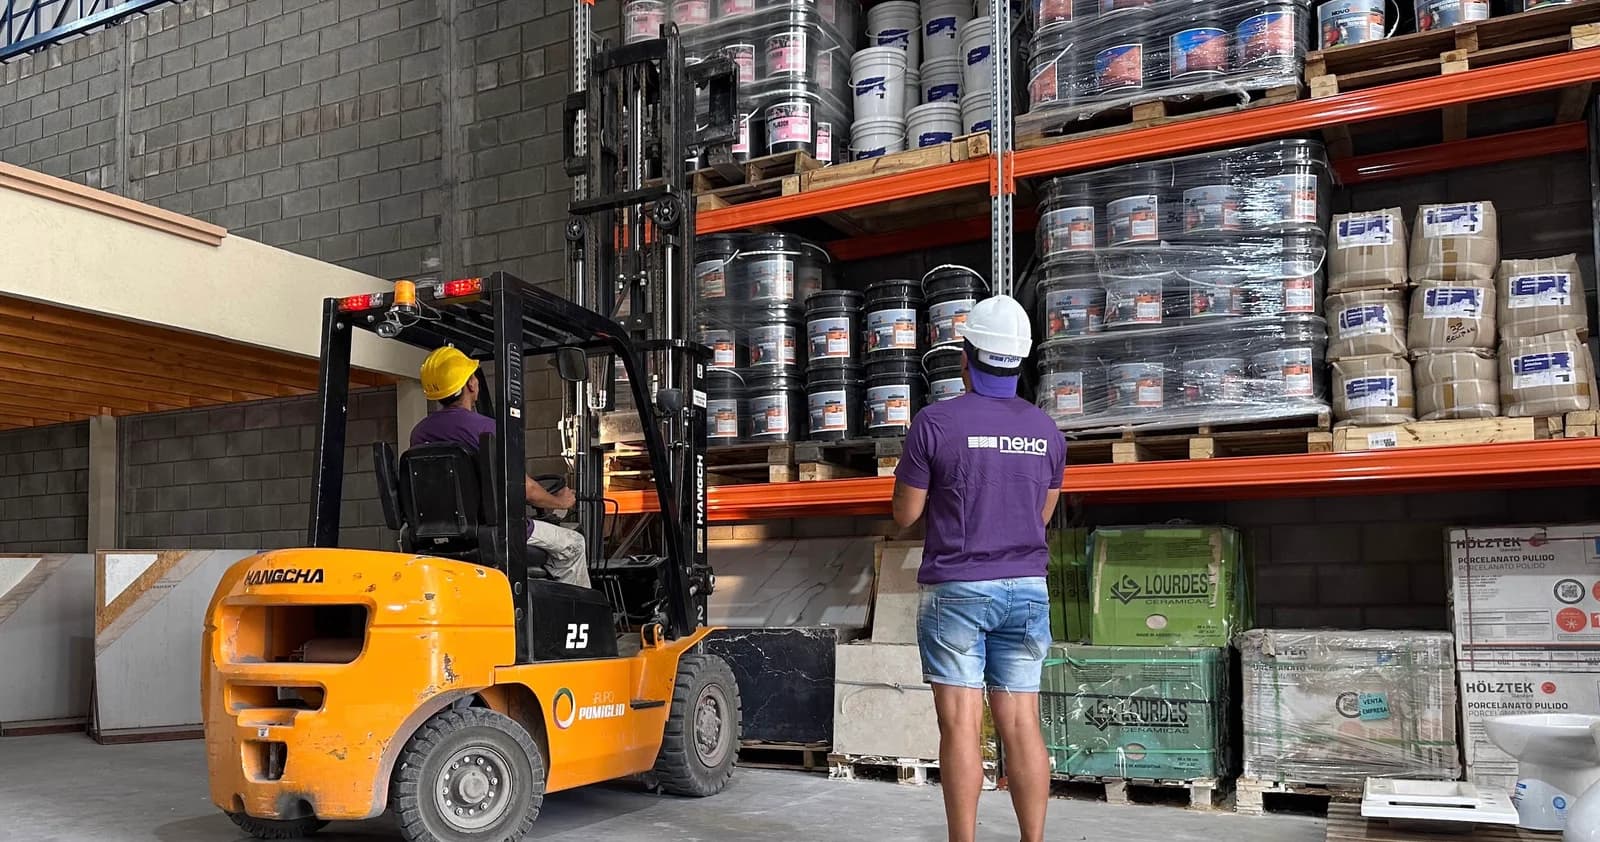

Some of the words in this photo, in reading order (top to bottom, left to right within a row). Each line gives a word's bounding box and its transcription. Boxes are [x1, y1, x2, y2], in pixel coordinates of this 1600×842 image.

[1458, 554, 1520, 564] PORCELANATO
[1522, 554, 1555, 562] PULIDO
[244, 568, 324, 585] HANGCHA
[1145, 574, 1208, 595] LOURDES
[565, 623, 589, 649] 25
[1466, 681, 1533, 694] HÖLZTEK
[1363, 697, 1383, 705] VENTA
[1468, 702, 1532, 711] PORCELANATO
[1535, 702, 1569, 710] PULIDO
[579, 704, 625, 720] POMIGLIO
[1121, 699, 1189, 724] LOURDES
[1362, 707, 1387, 715] EMPRESA
